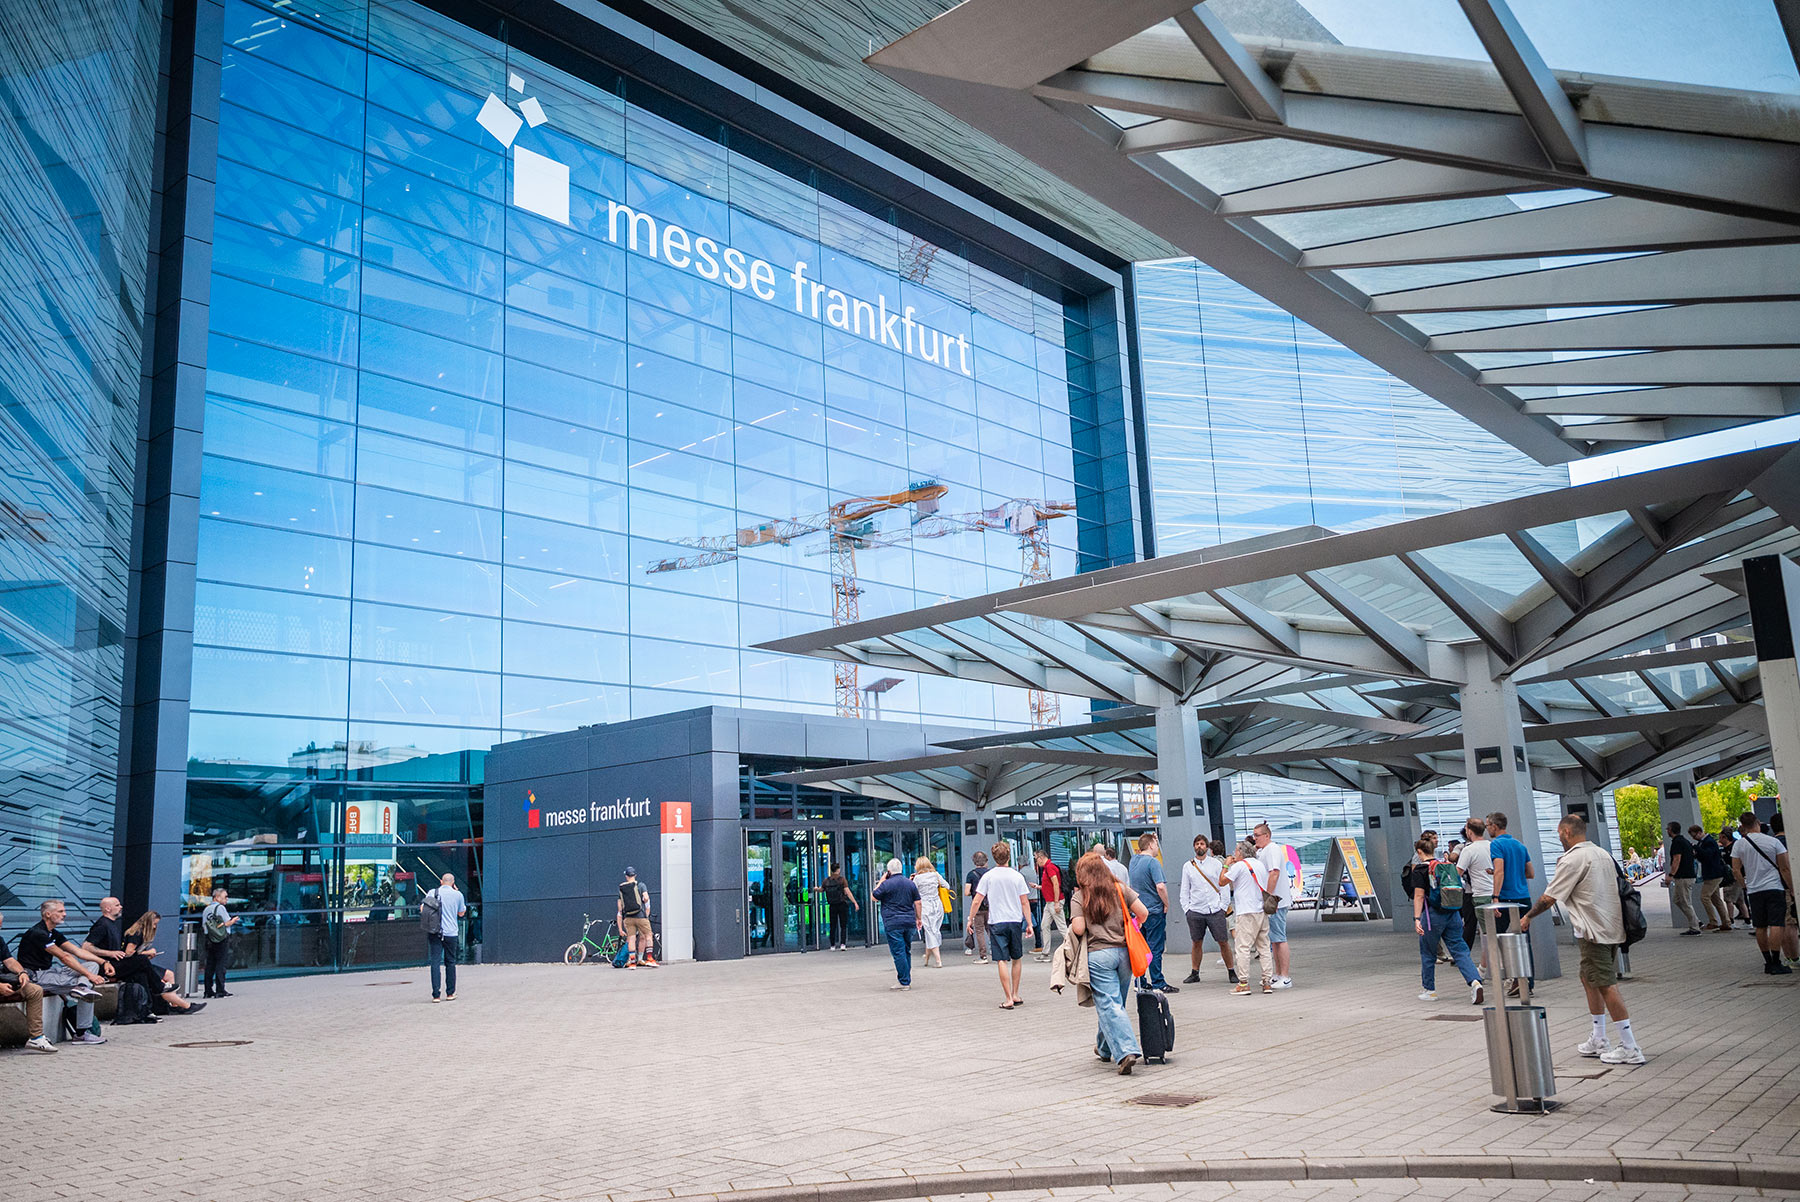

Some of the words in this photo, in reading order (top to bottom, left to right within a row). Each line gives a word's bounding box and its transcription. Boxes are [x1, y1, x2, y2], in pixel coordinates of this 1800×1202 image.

[608, 199, 776, 301] messe
[791, 261, 971, 376] frankfurt
[349, 811, 358, 834] BAF
[545, 808, 587, 827] messe
[590, 797, 651, 822] frankfurt
